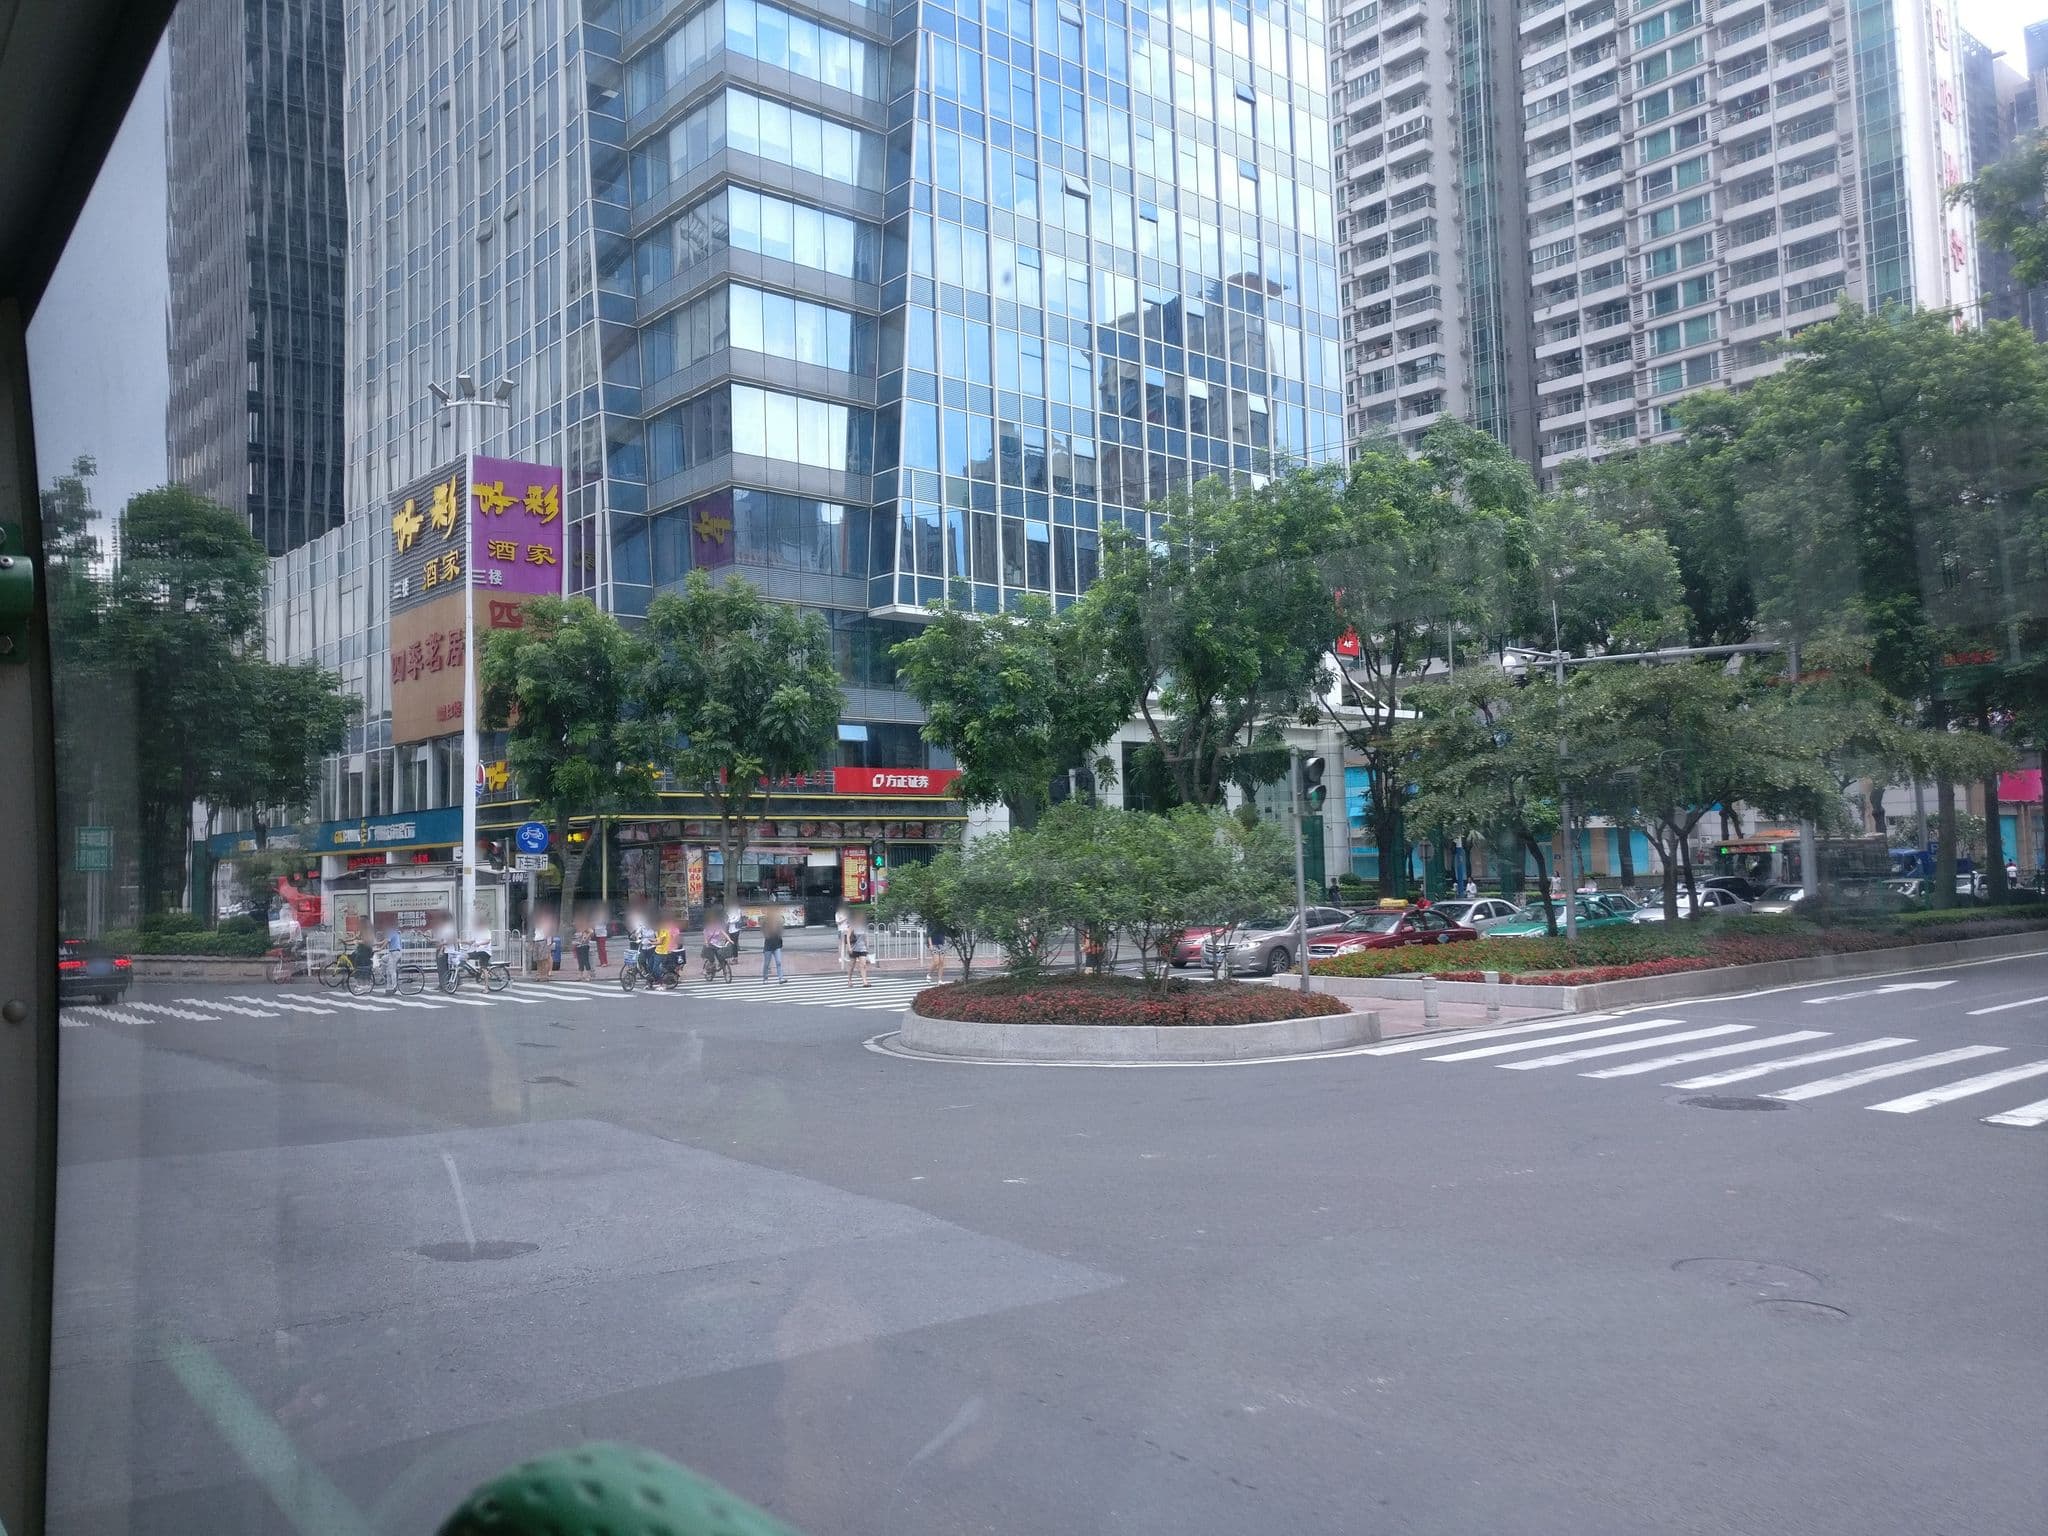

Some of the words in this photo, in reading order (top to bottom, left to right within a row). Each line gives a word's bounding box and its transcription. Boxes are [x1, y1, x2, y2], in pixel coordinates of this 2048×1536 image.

[472, 480, 560, 524] 好彩
[421, 550, 461, 591] 酒家
[487, 539, 557, 565] 酒家
